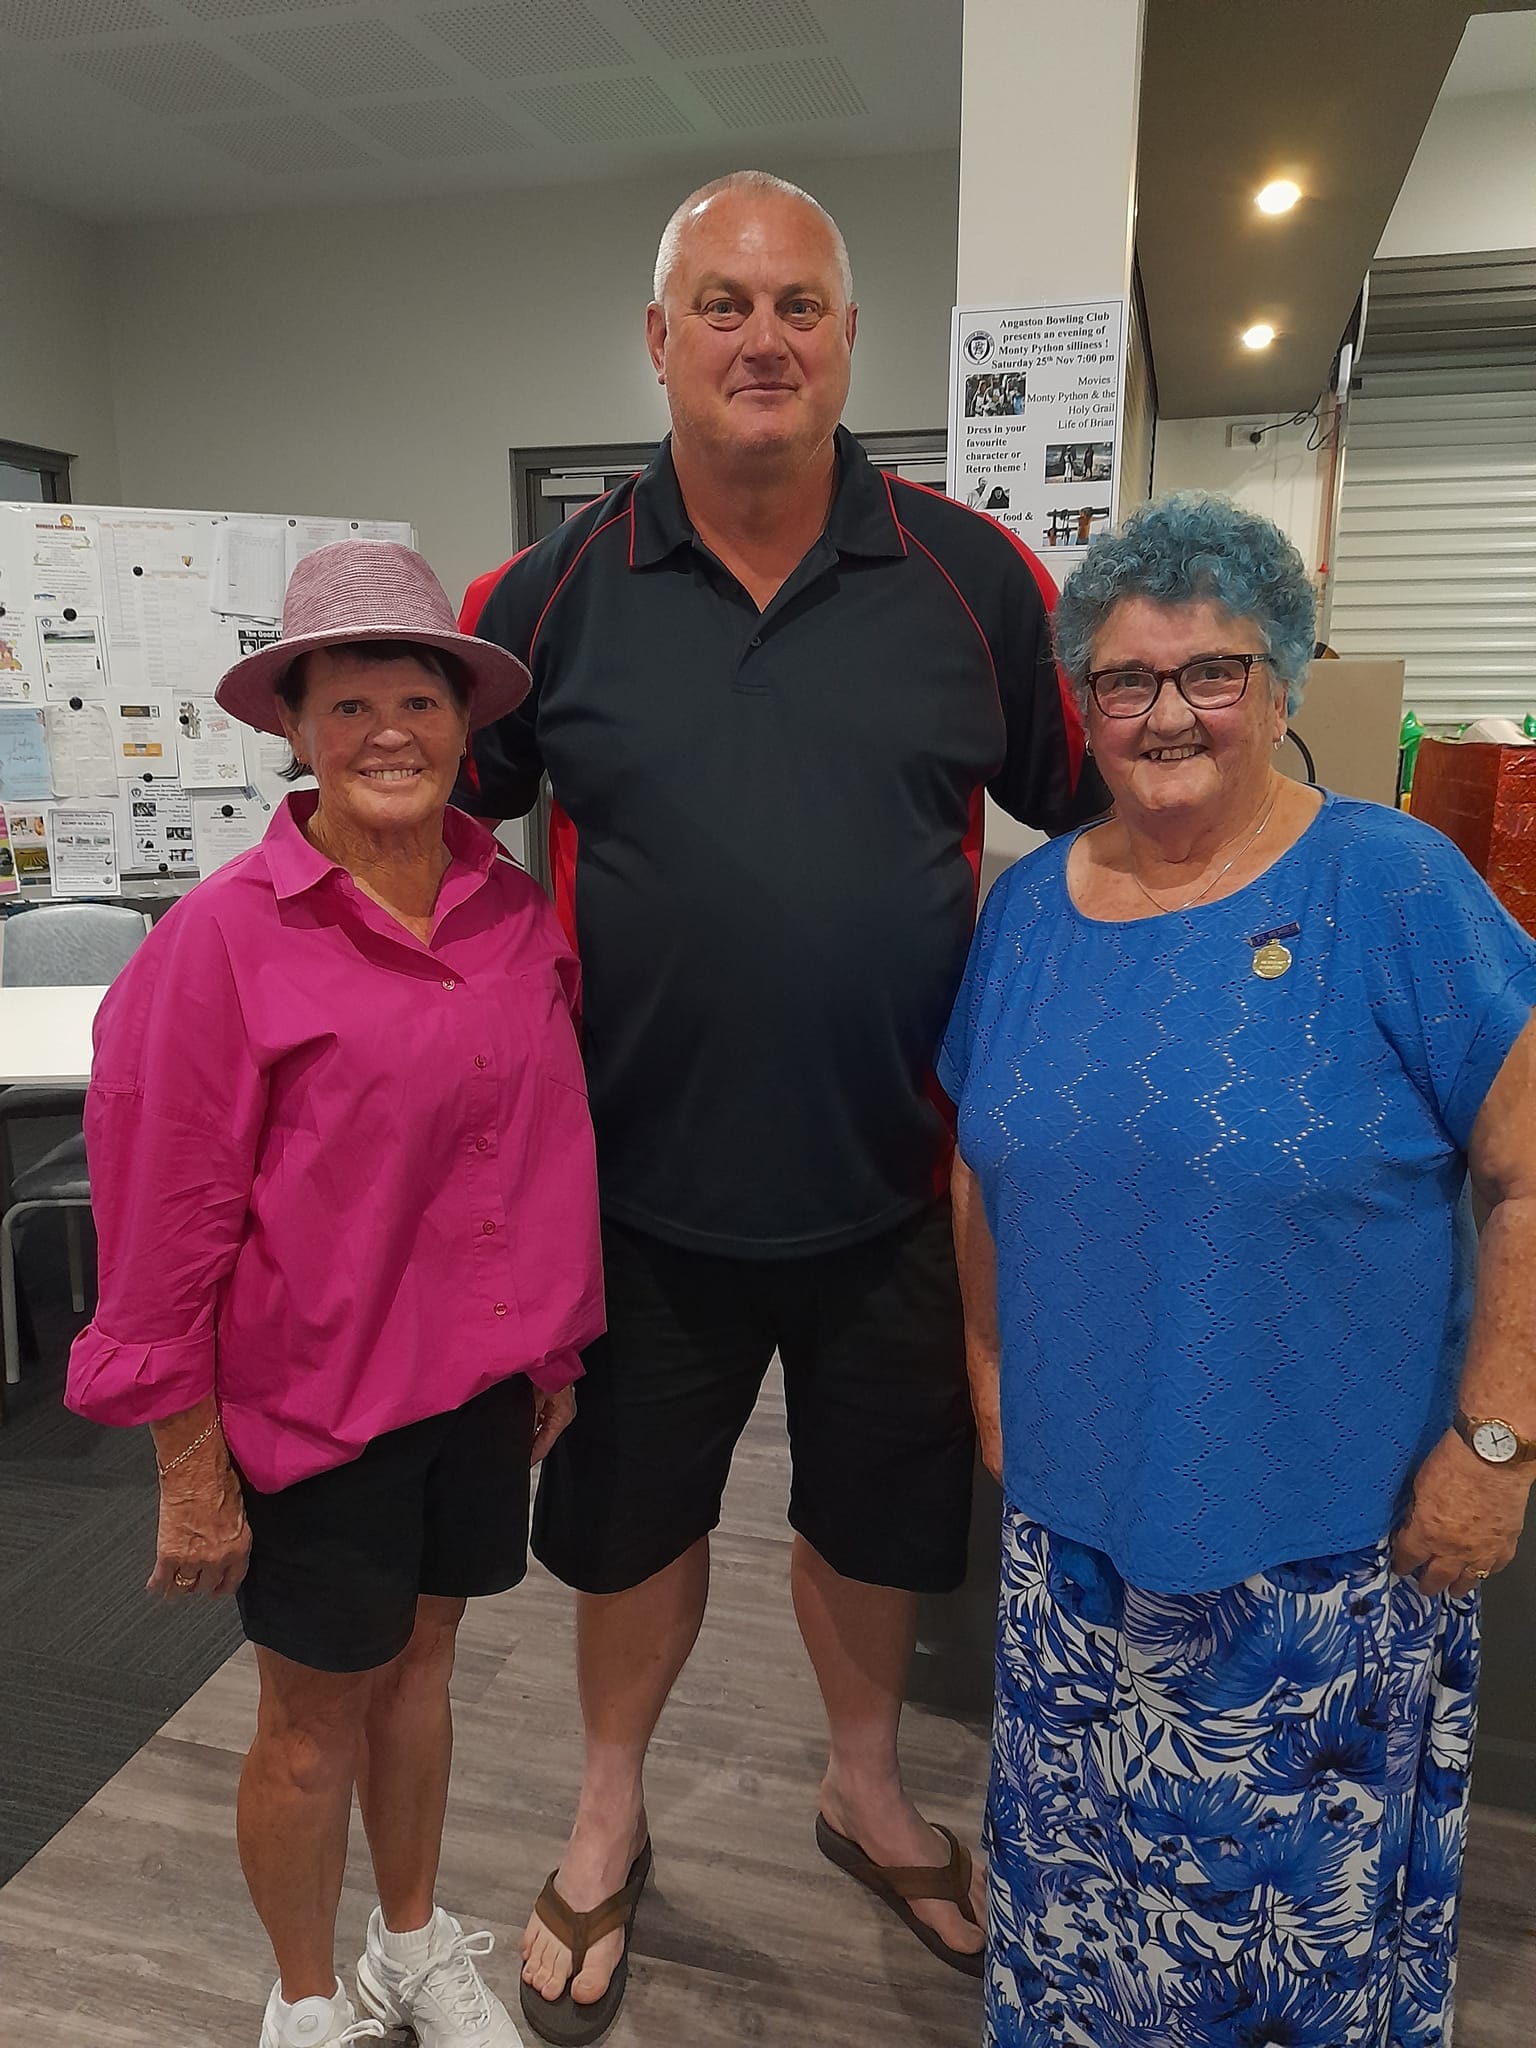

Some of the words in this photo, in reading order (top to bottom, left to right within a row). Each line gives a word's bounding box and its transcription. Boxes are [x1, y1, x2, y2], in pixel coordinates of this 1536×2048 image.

[1000, 318, 1044, 329] Angaston
[1046, 314, 1084, 326] Bowling
[1086, 311, 1110, 322] Club
[1003, 331, 1041, 344] presents
[1044, 330, 1055, 339] an
[1058, 326, 1093, 339] evening
[1095, 325, 1106, 335] of
[998, 345, 1029, 356] Monty
[1031, 343, 1064, 355] Python
[1067, 340, 1102, 351] silliness
[991, 358, 1034, 370] Saturday
[1036, 355, 1053, 366] 25th
[1056, 355, 1075, 365] Nov
[1078, 353, 1097, 364] 7:00
[1099, 354, 1115, 365] pm
[1078, 376, 1111, 386] Movies
[1027, 393, 1056, 404] Monty
[1058, 391, 1089, 403] Python
[1091, 390, 1100, 399] &
[1102, 389, 1116, 398] the
[1068, 404, 1090, 416] Holy
[1092, 403, 1115, 413] Grail
[1058, 419, 1076, 429] Life
[1078, 418, 1088, 428] of
[1090, 418, 1114, 427] Brian
[967, 425, 992, 434] Dress
[994, 425, 1003, 434] in
[1005, 425, 1027, 435] your
[966, 438, 1007, 448] favourite
[965, 451, 1009, 460] character
[1010, 451, 1021, 459] or
[966, 464, 991, 474] Retro
[993, 463, 1021, 473] theme
[1003, 512, 1022, 522] food
[1025, 511, 1034, 521] &
